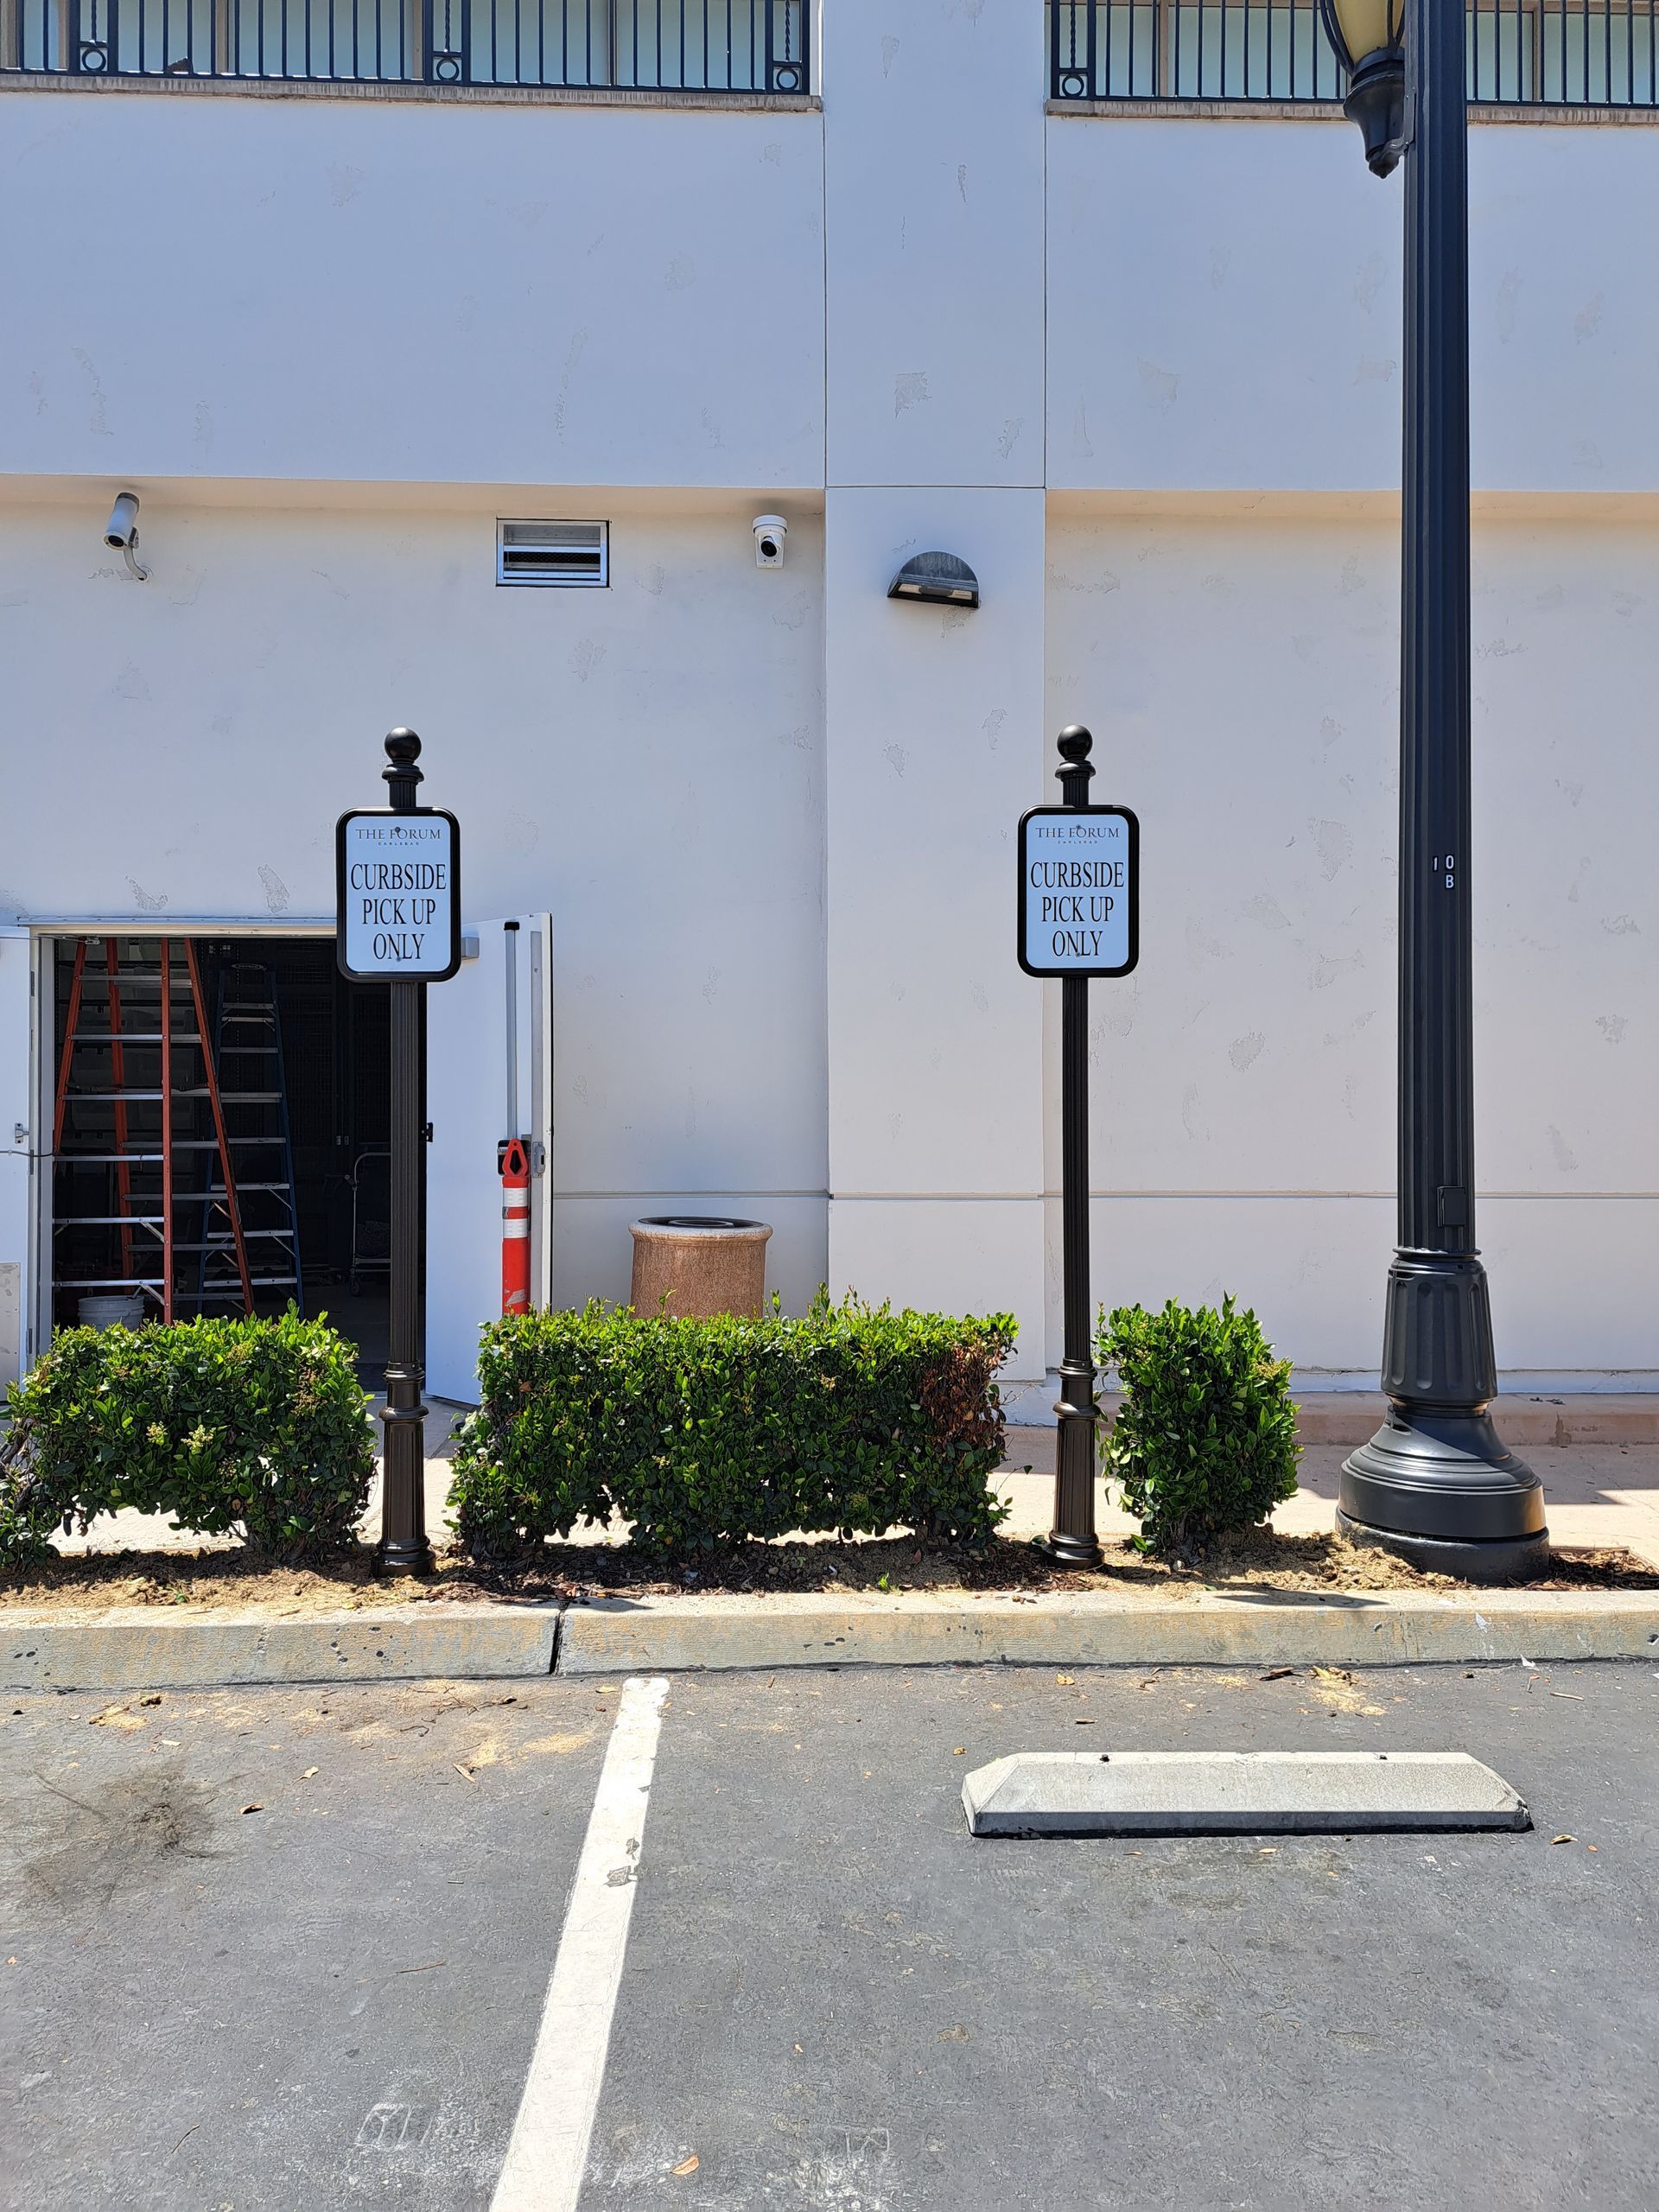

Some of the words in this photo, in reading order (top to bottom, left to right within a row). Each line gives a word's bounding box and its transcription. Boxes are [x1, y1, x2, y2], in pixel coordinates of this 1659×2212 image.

[355, 829, 385, 840] THE
[390, 829, 441, 840] FORUM
[1035, 827, 1065, 838] THE
[1069, 827, 1120, 838] FORUM
[350, 863, 447, 890] CURBSIDE
[1030, 861, 1125, 888] CURBSIDE
[1446, 874, 1455, 889] B
[361, 898, 406, 925] PICK
[411, 898, 436, 925] UP
[1041, 896, 1085, 923] PICK
[1090, 896, 1115, 923] UP
[372, 933, 426, 960] ONLY
[1052, 930, 1104, 957] ONLY
